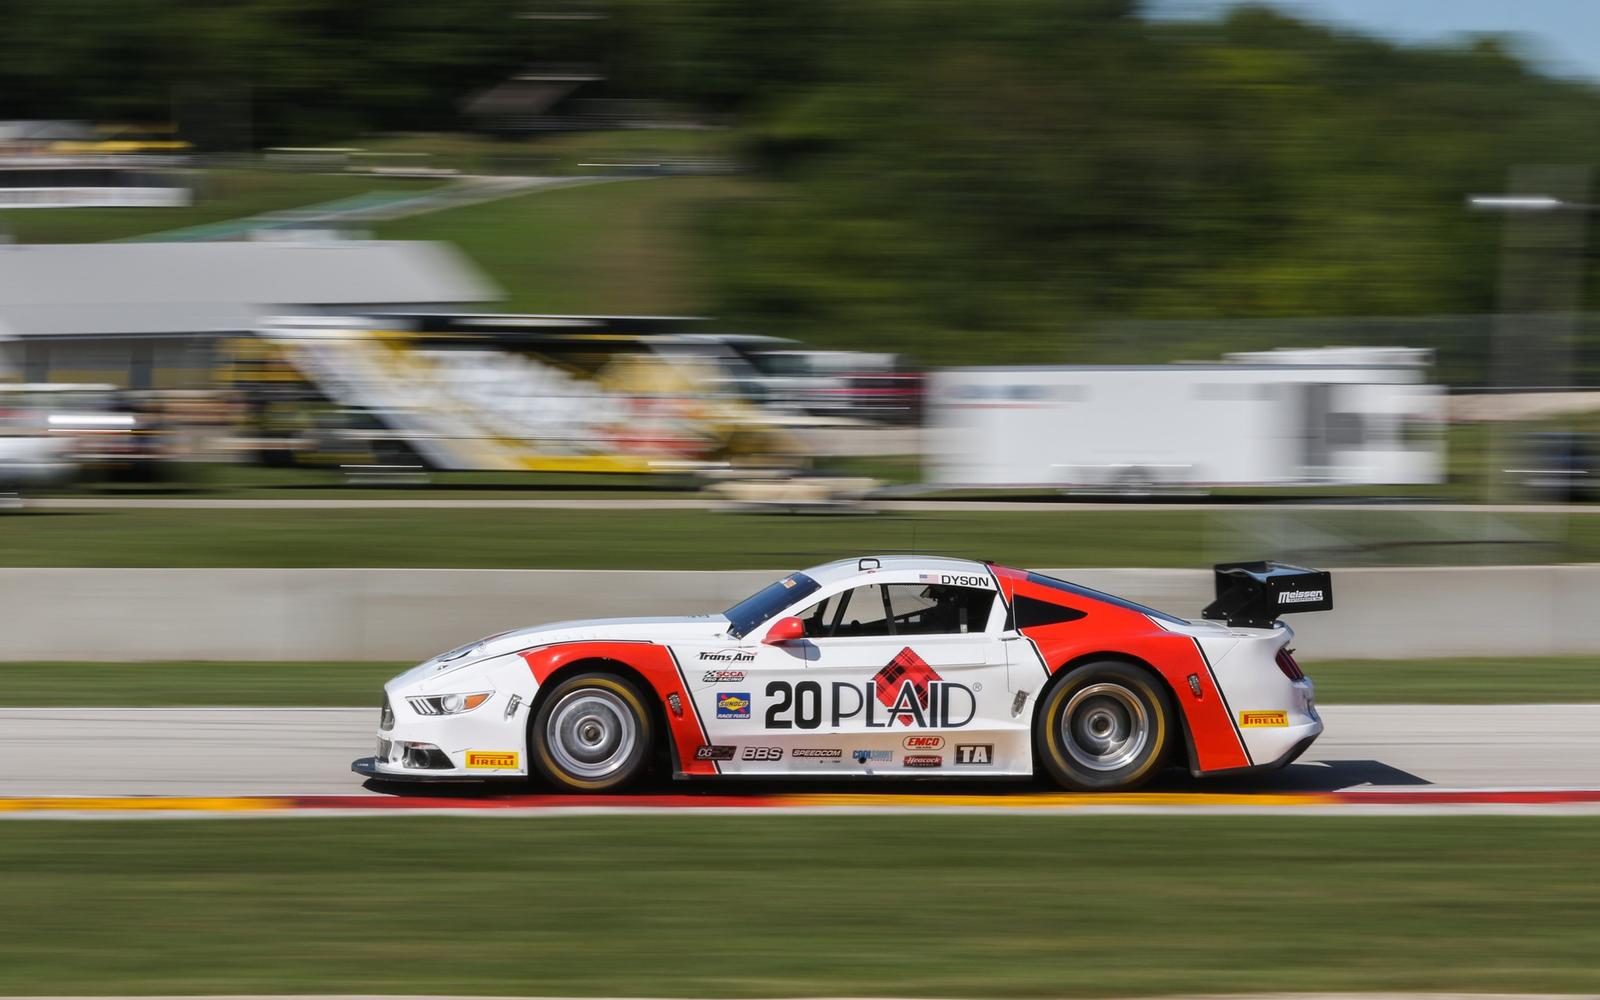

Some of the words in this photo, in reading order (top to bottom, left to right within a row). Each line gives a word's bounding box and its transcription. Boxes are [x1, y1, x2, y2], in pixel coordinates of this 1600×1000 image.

[941, 575, 989, 587] DYSON
[1278, 590, 1323, 604] Meissen
[699, 652, 732, 661] Trans
[733, 652, 755, 661] Am
[765, 681, 822, 729] 20
[831, 681, 977, 728] PLAID
[1243, 713, 1285, 725] PIRELLI
[907, 737, 941, 746] EMCO
[742, 747, 783, 761] BBS
[792, 749, 841, 757] SPEEDCOM
[960, 746, 988, 763] TA
[470, 754, 514, 766] PIRELLI
[905, 756, 941, 764] Heacock
